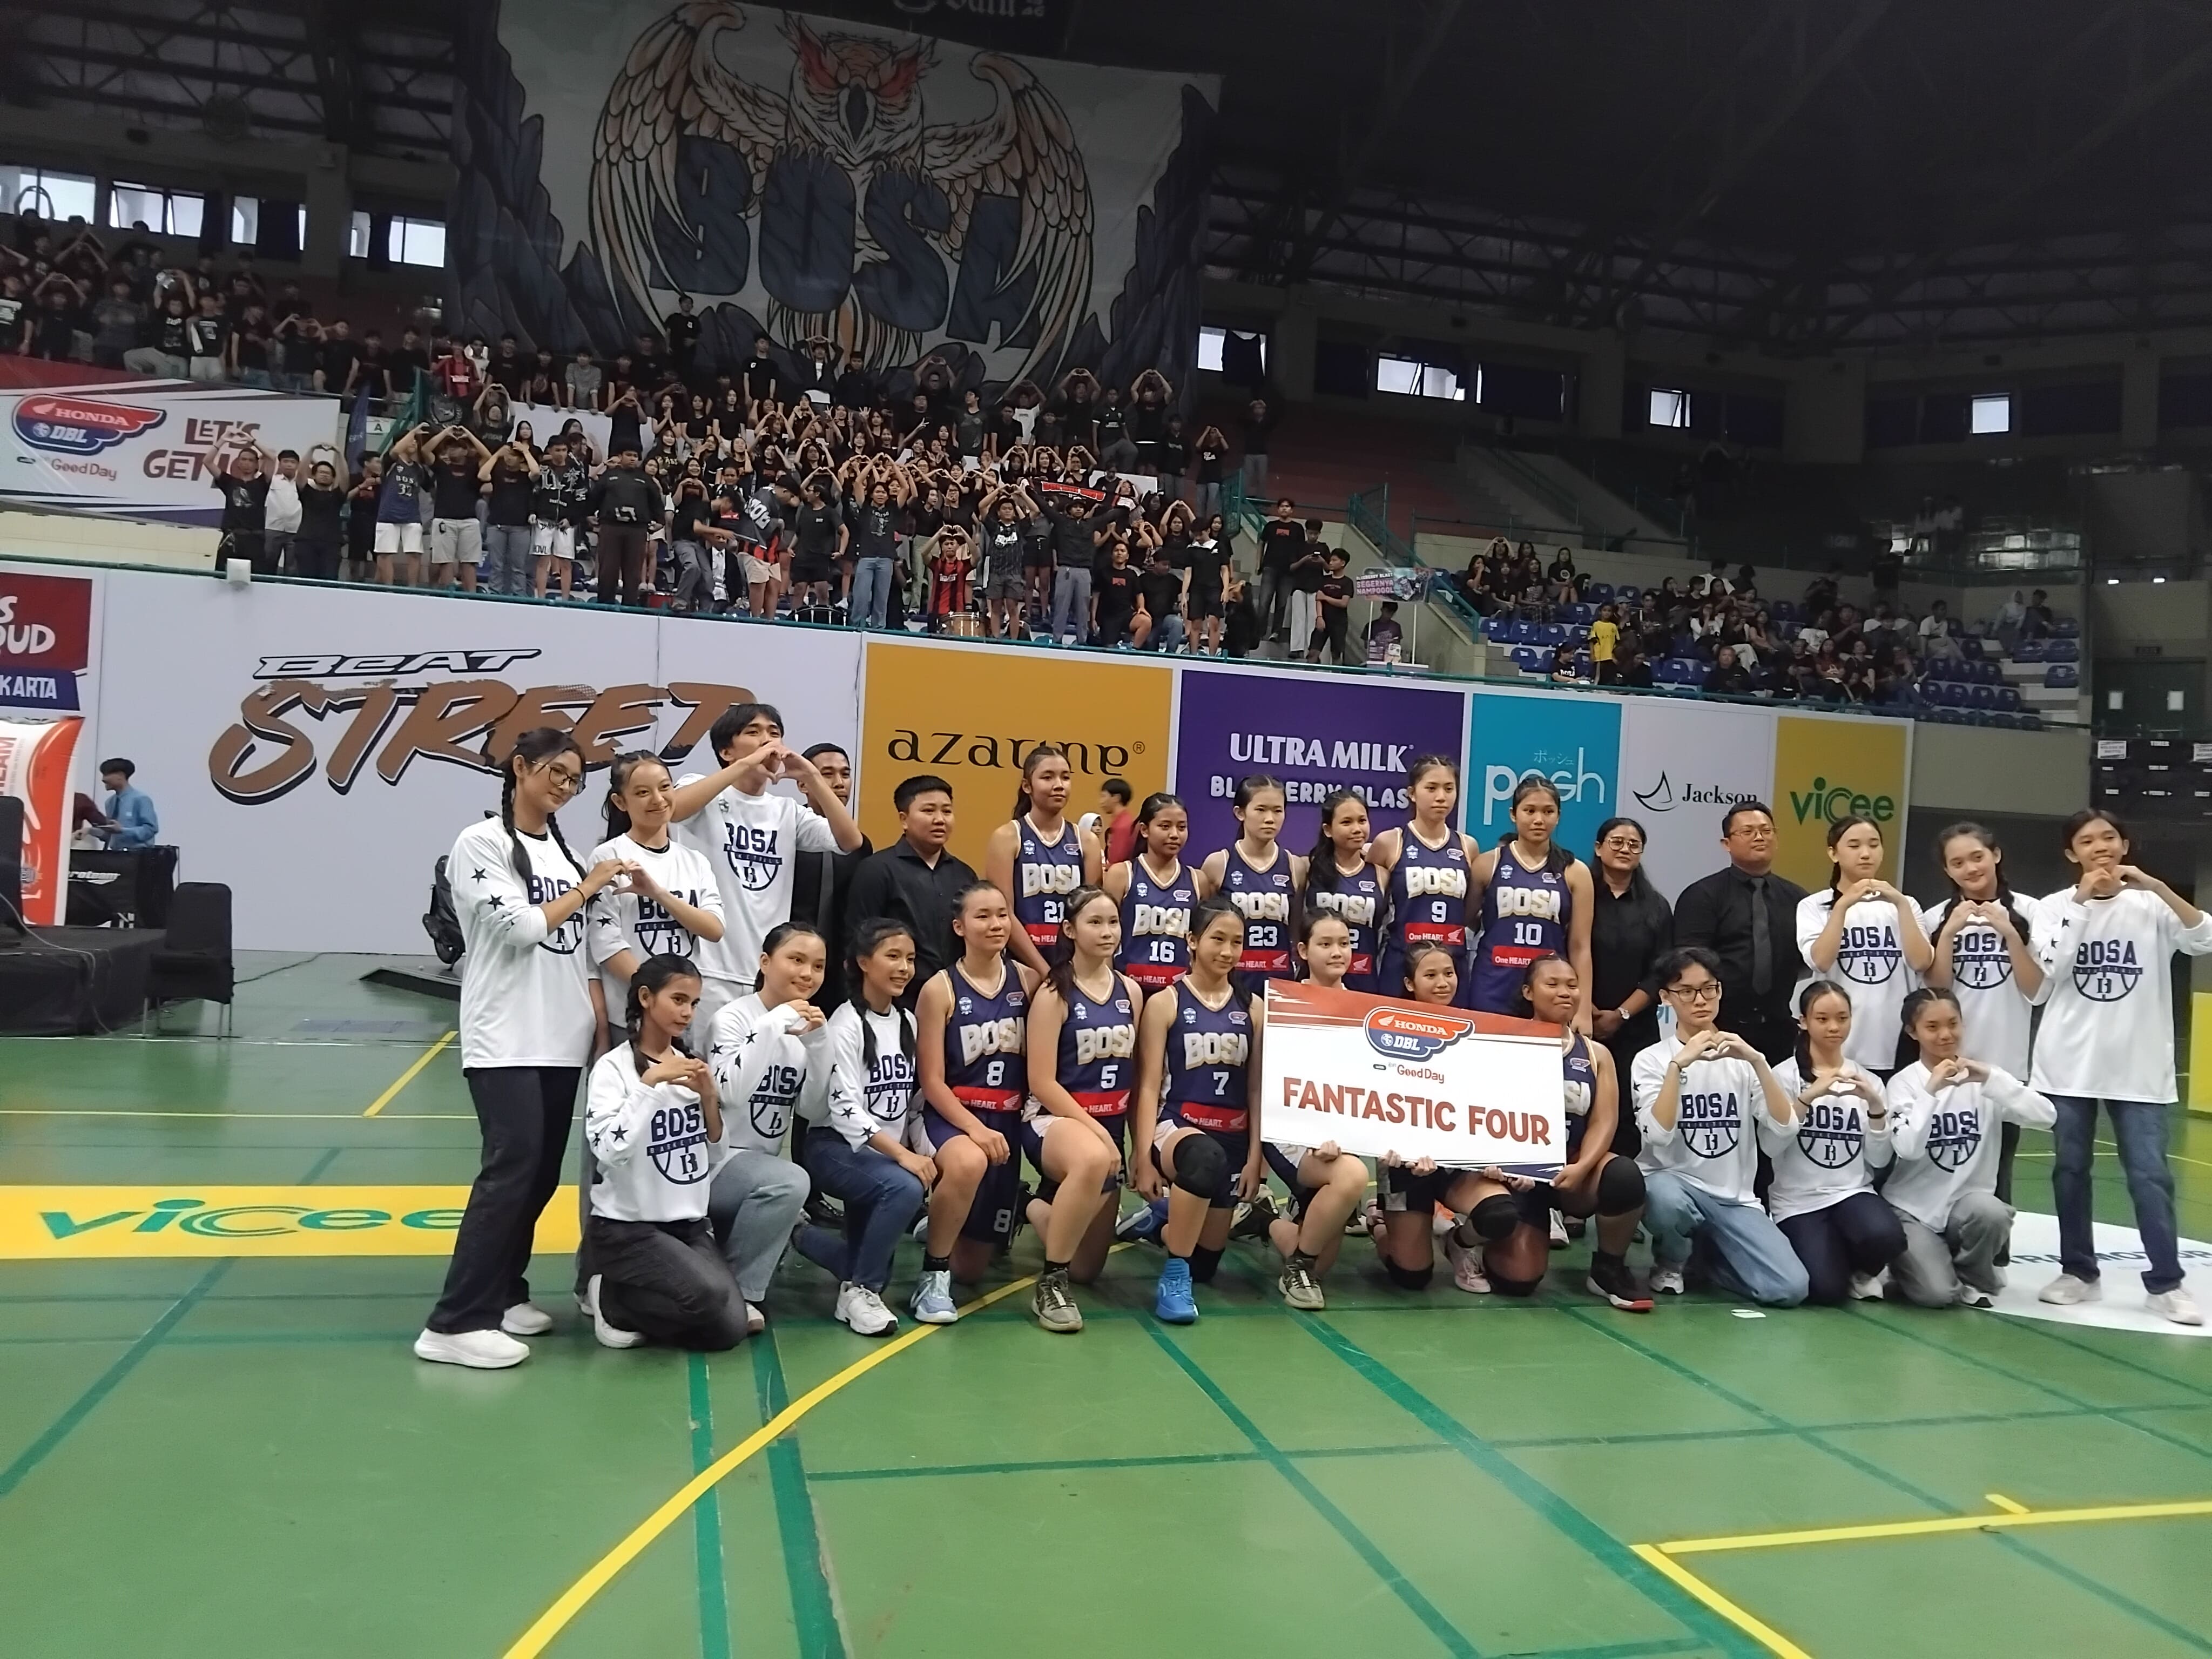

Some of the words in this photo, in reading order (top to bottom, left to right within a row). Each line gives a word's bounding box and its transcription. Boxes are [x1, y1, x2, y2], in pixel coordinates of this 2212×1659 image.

[55, 408, 130, 427] HONDA
[374, 423, 382, 431] A
[49, 427, 87, 443] DBL
[1357, 579, 1394, 588] SEGERNYA
[1357, 586, 1394, 595] NAMPOOOL
[1230, 733, 1327, 767] ULTRA
[1331, 740, 1407, 773] MILK
[1211, 775, 1342, 804] BLERRY
[1682, 783, 1757, 805] Jackson
[1790, 777, 1895, 826] vicee
[1405, 866, 1467, 899] BOSA
[1432, 901, 1447, 922] 9
[1497, 886, 1561, 924] BOSA
[1249, 926, 1277, 947] 23
[1514, 922, 1542, 945] 10
[1149, 941, 1175, 963] 16
[2076, 939, 2137, 965] BOSA
[1393, 1020, 1448, 1036] HONDA
[1183, 1032, 1249, 1070] BOSA
[1393, 1035, 1421, 1051] DBL
[986, 1061, 1005, 1086] 8
[1100, 1064, 1118, 1089] 5
[1213, 1071, 1230, 1096] 7
[1397, 1064, 1423, 1078] Good
[1425, 1068, 1444, 1084] Day
[1283, 1076, 1456, 1132] FANTASTIC
[1468, 1105, 1551, 1146] FOUR
[1681, 1092, 1738, 1119] BOSA
